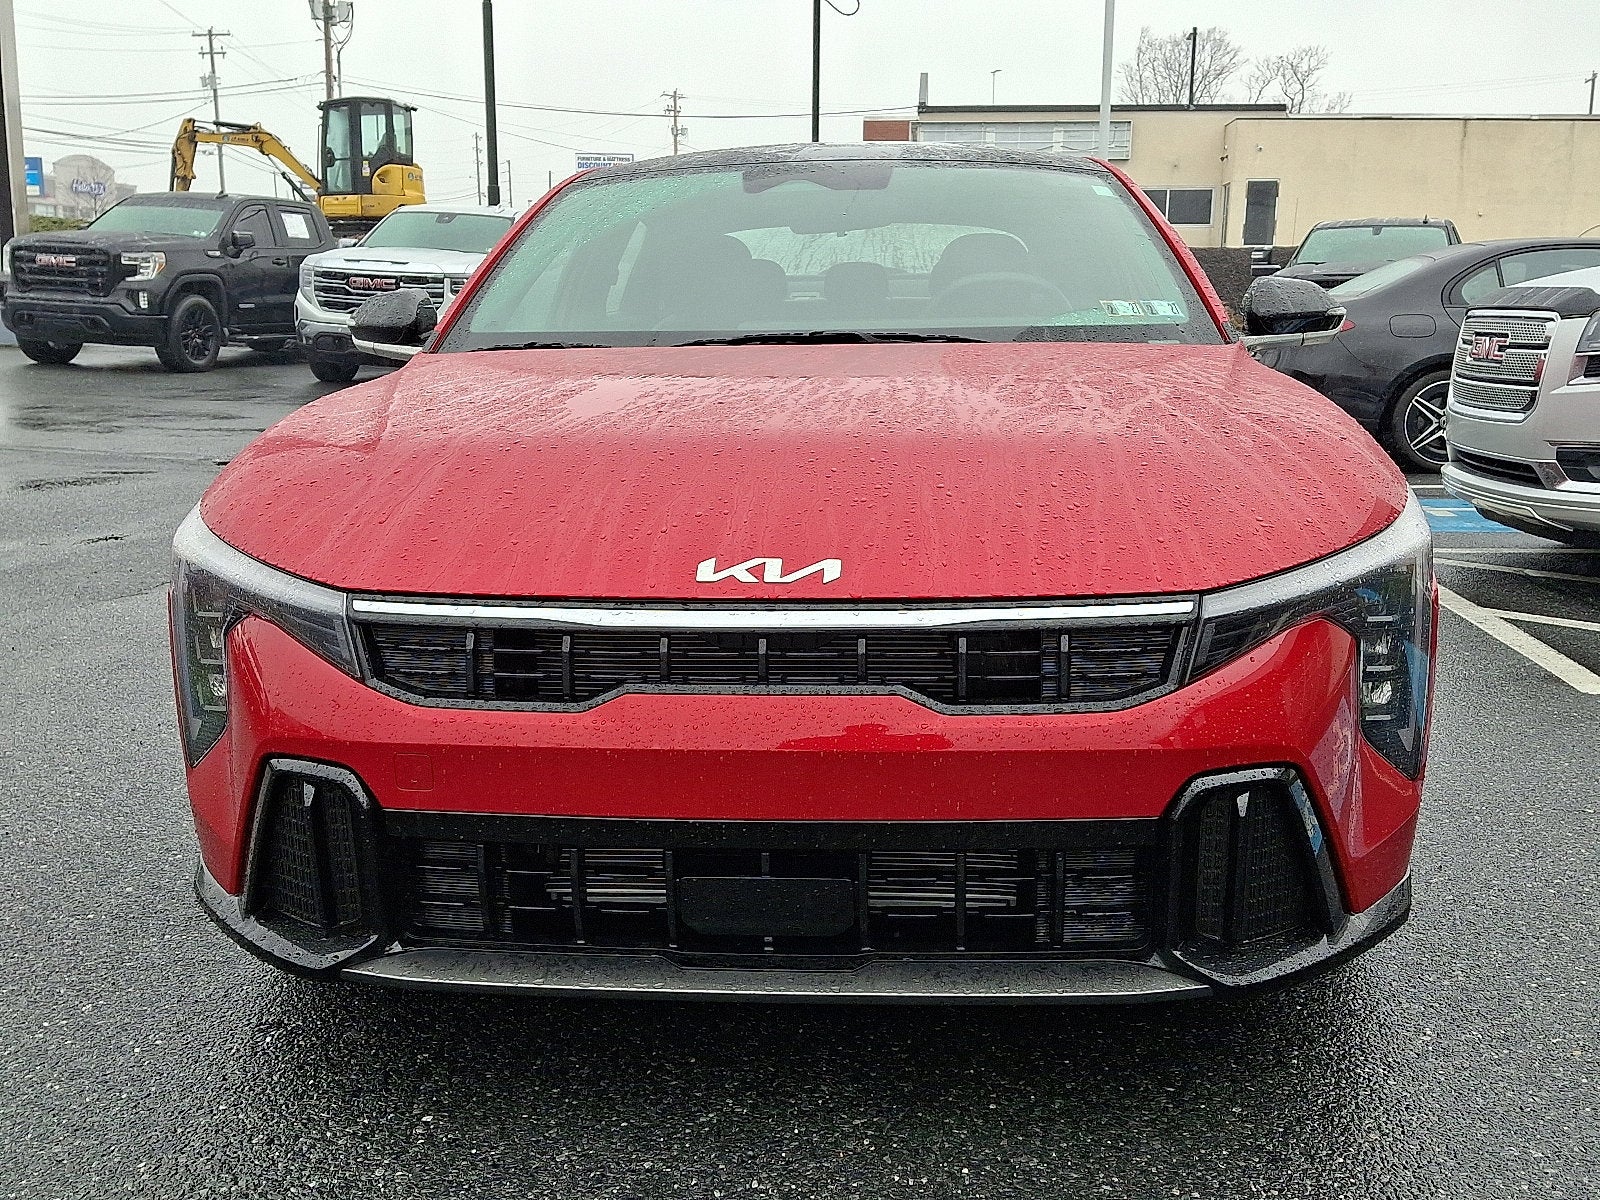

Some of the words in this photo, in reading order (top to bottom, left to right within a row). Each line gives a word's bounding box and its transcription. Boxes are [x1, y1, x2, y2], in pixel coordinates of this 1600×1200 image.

[36, 254, 76, 267] GMC
[348, 276, 396, 289] GMC
[1471, 337, 1509, 359] GMC
[696, 557, 842, 585] KIA
